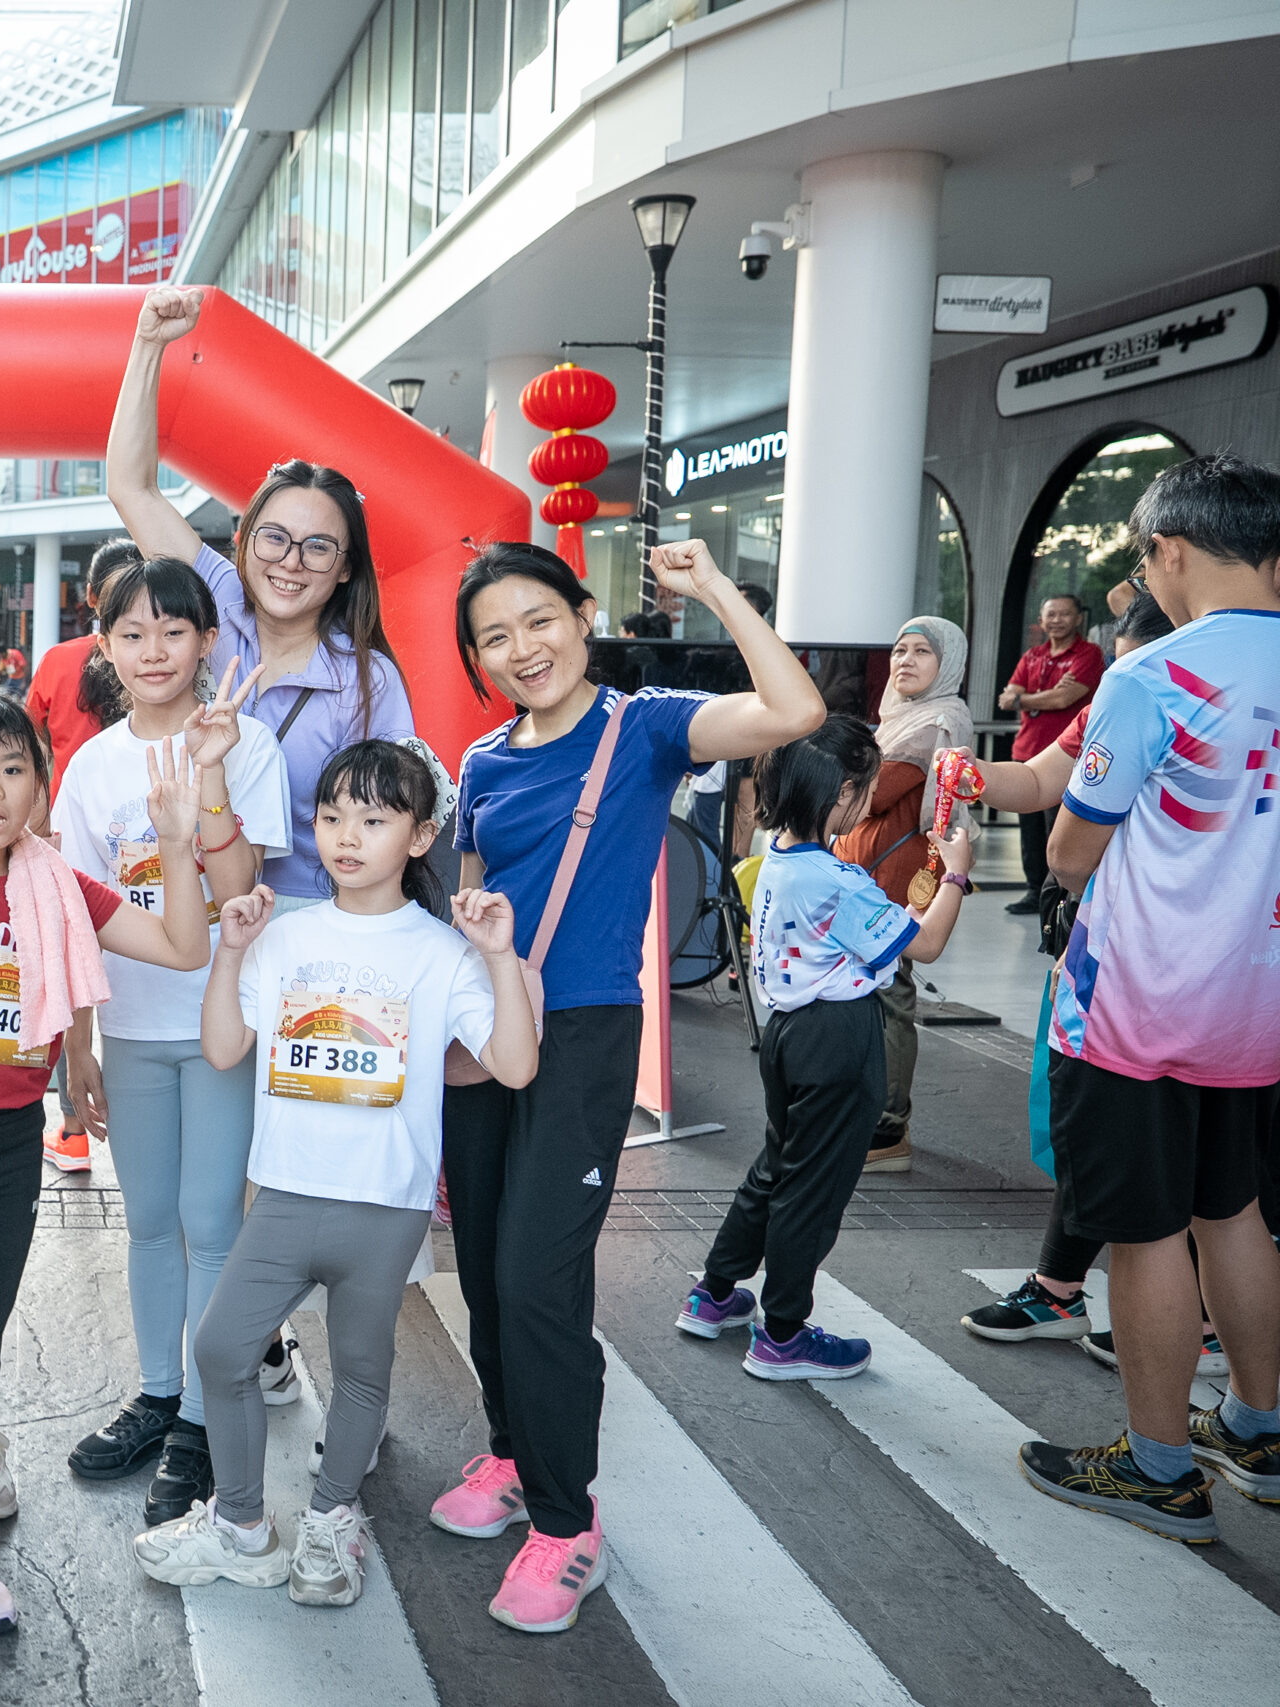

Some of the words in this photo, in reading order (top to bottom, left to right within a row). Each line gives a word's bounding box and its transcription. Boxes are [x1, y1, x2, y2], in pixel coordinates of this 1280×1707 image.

[942, 298, 990, 307] NAUGHTY
[1015, 347, 1105, 389] NAUGHTY
[1103, 330, 1162, 365] BABE
[290, 1044, 318, 1068] BF
[325, 1048, 377, 1074] 388
